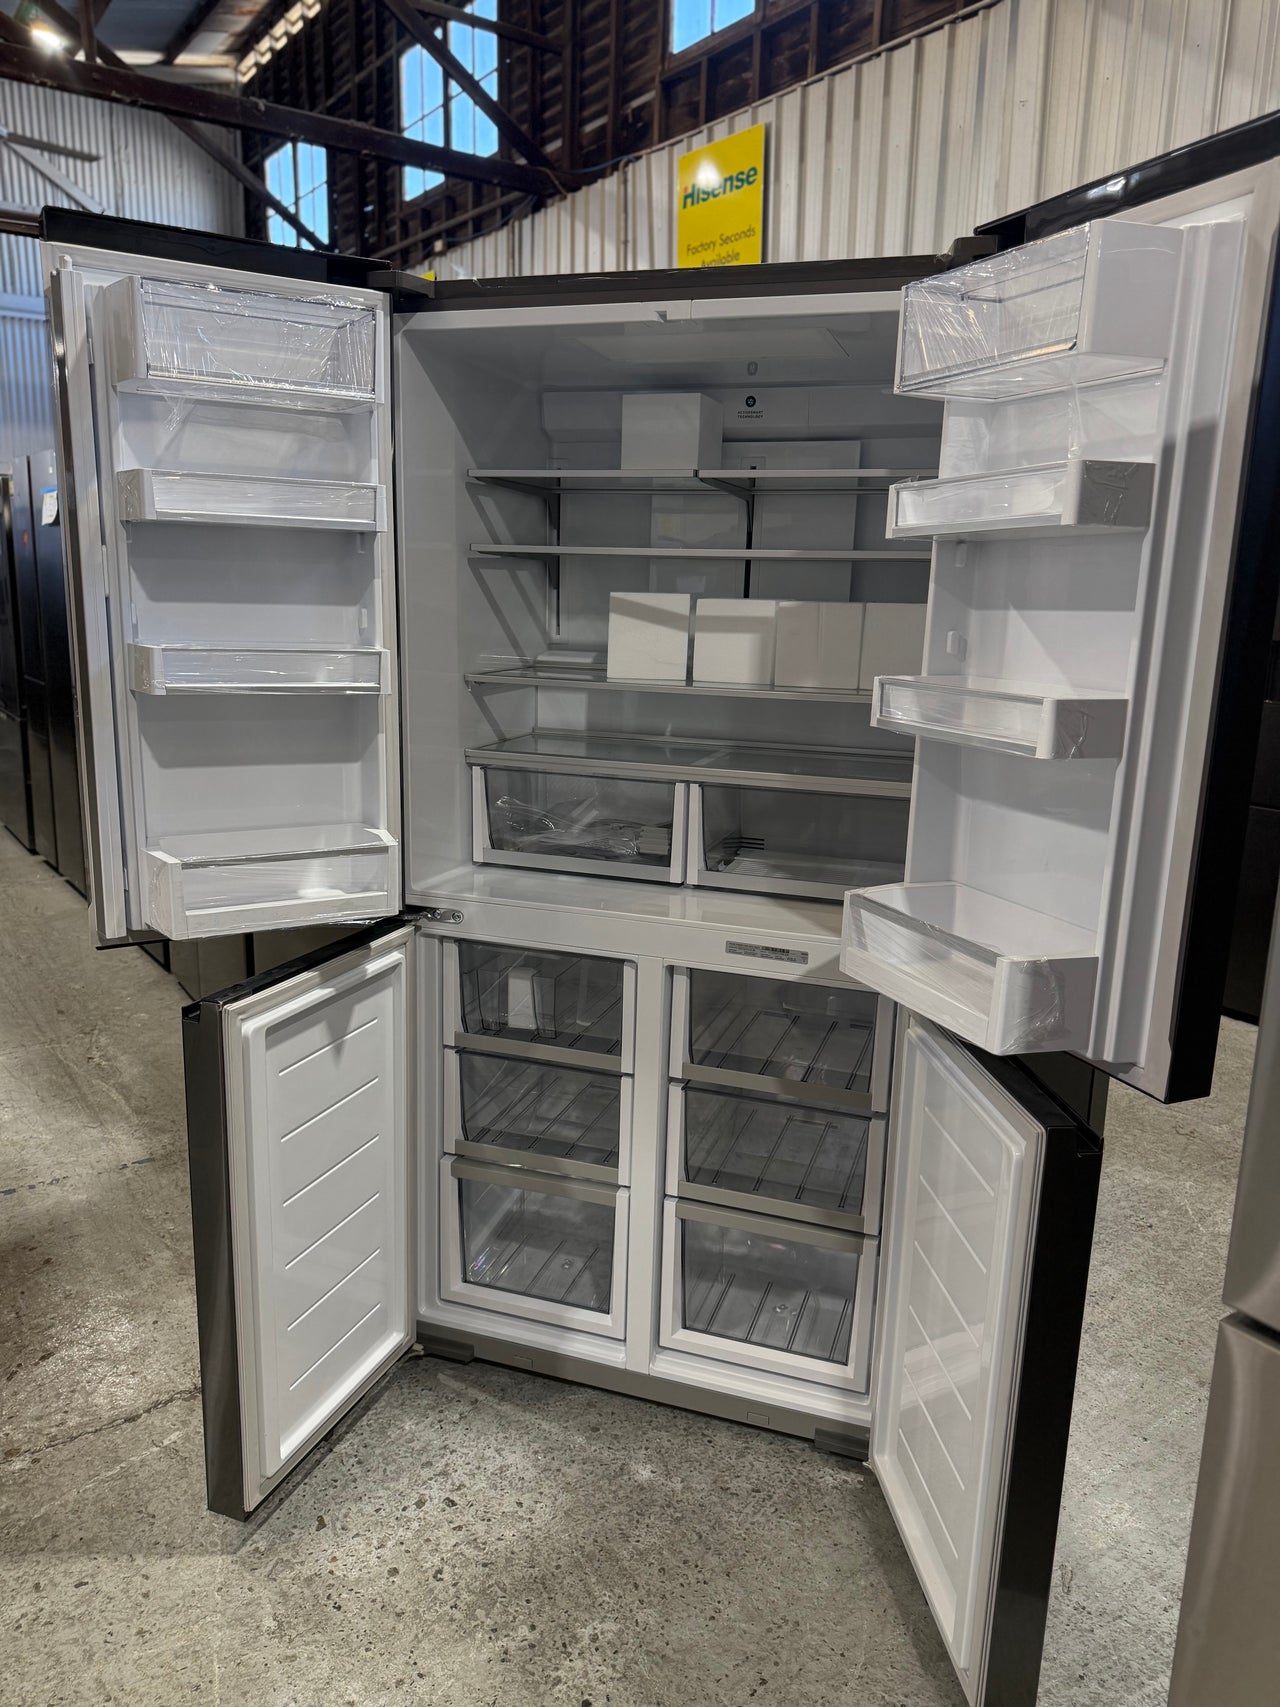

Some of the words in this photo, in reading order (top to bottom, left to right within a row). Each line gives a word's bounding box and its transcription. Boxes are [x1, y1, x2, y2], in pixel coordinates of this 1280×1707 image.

[683, 167, 758, 209] Hisense
[687, 239, 716, 256] Factory
[719, 225, 756, 246] Seconds
